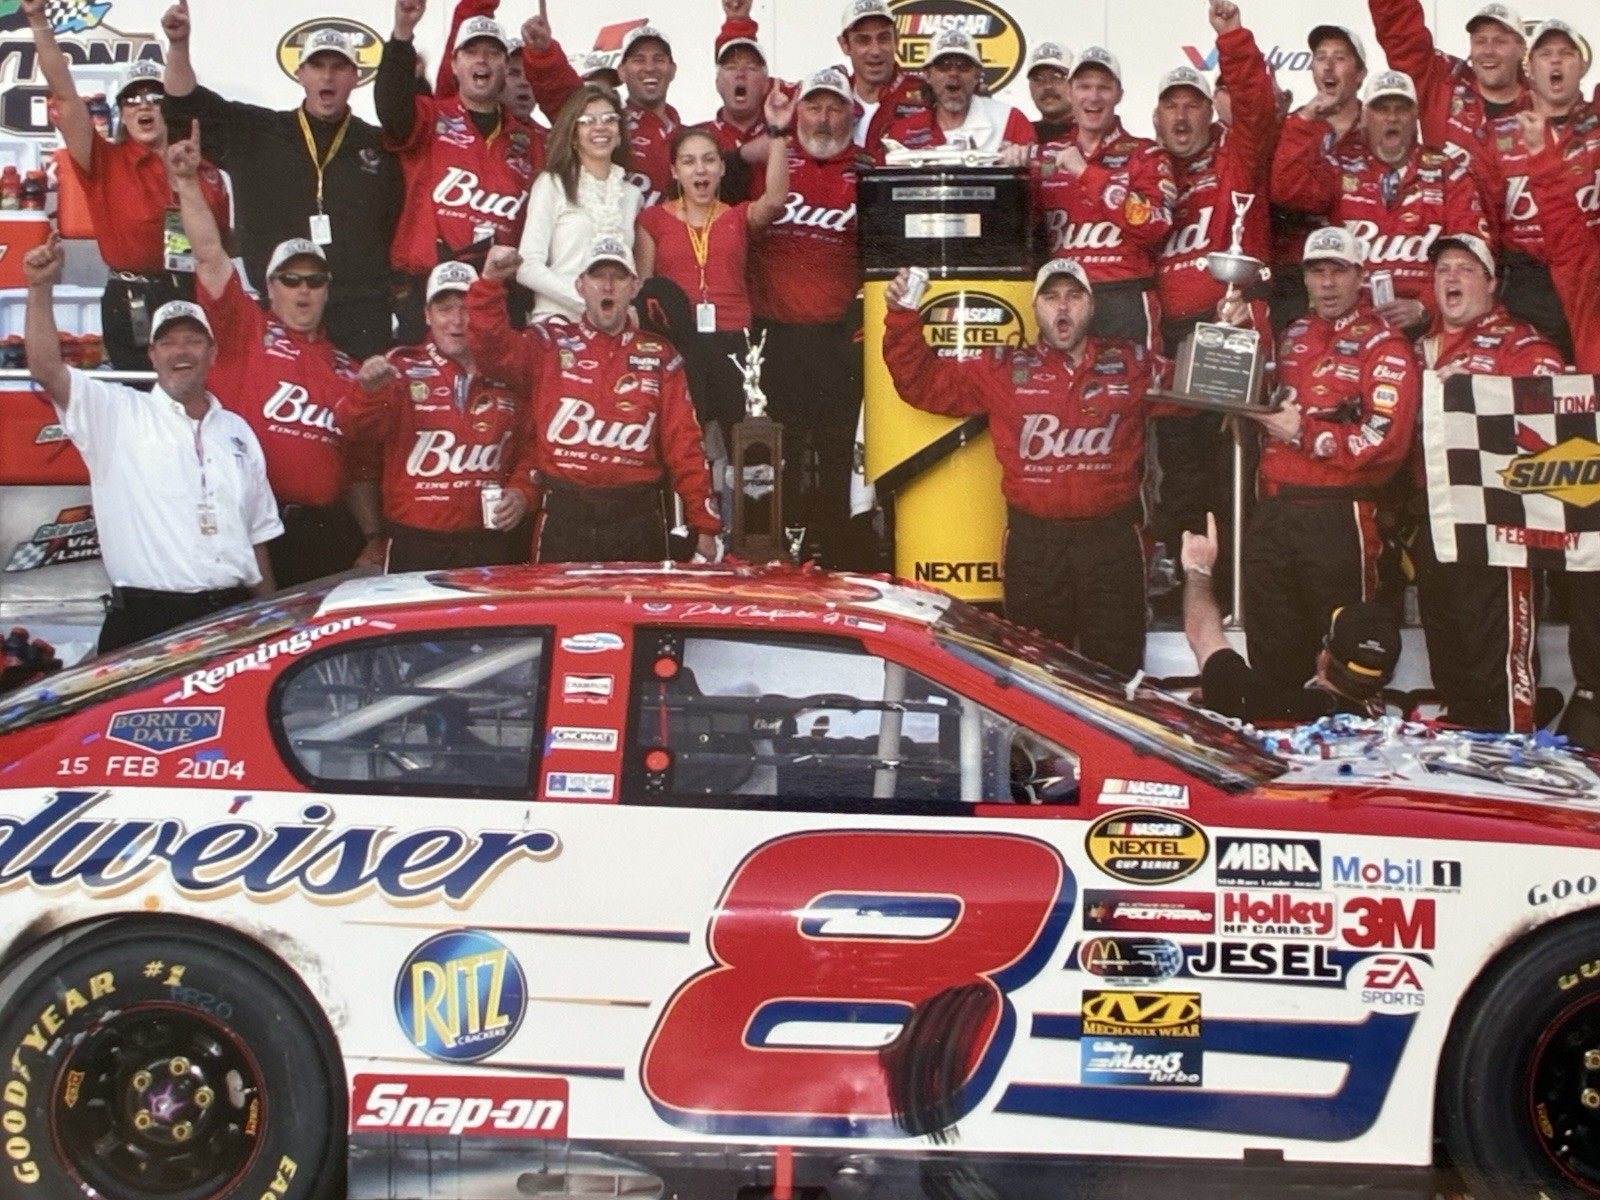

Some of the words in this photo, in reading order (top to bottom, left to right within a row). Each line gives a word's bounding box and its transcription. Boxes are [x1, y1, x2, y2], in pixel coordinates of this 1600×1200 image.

[918, 14, 990, 35] NASCAR
[432, 166, 528, 220] Bud
[772, 191, 857, 232] Bud
[1343, 219, 1442, 264] Bud
[952, 306, 1004, 323] NASCAR
[931, 327, 1004, 344] NEXTEL
[263, 380, 343, 436] Bu
[546, 397, 657, 453] Bud
[1019, 413, 1121, 461] Bud
[406, 429, 513, 477] Bud
[553, 447, 588, 460] KING
[1023, 463, 1053, 474] KING
[415, 481, 449, 490] KING
[67, 535, 97, 548] Vic
[915, 562, 1003, 583] NEXTEL
[181, 615, 368, 699] Remington
[114, 712, 179, 731] BORN
[183, 711, 219, 729] ON
[132, 728, 193, 744] DATE
[57, 757, 89, 775] 15
[106, 756, 159, 777] FEB
[175, 758, 245, 780] 2004
[1126, 781, 1184, 797] NASCAR
[1130, 822, 1184, 836] NASCAR
[1109, 840, 1185, 856] NEXTEL
[1218, 842, 1320, 872] MBNA
[1115, 860, 1139, 869] CUP
[1141, 861, 1180, 870] SERIES
[1331, 855, 1421, 885] Mobil
[1223, 891, 1334, 936] Holley
[1341, 896, 1436, 949] 3M
[1224, 924, 1248, 935] HP
[1252, 924, 1314, 936] CARBS
[1190, 941, 1339, 978] JESEL
[639, 827, 1078, 1138] 8
[1363, 958, 1424, 991] EA
[411, 949, 511, 1049] RITZ
[1361, 990, 1425, 1007] SPORTS
[457, 1028, 507, 1046] CRACKERS
[1083, 1019, 1158, 1036] MECHANIX
[1159, 1025, 1201, 1037] WEAR
[1149, 1067, 1200, 1084] Turbo
[357, 1082, 564, 1135] Snap-on
